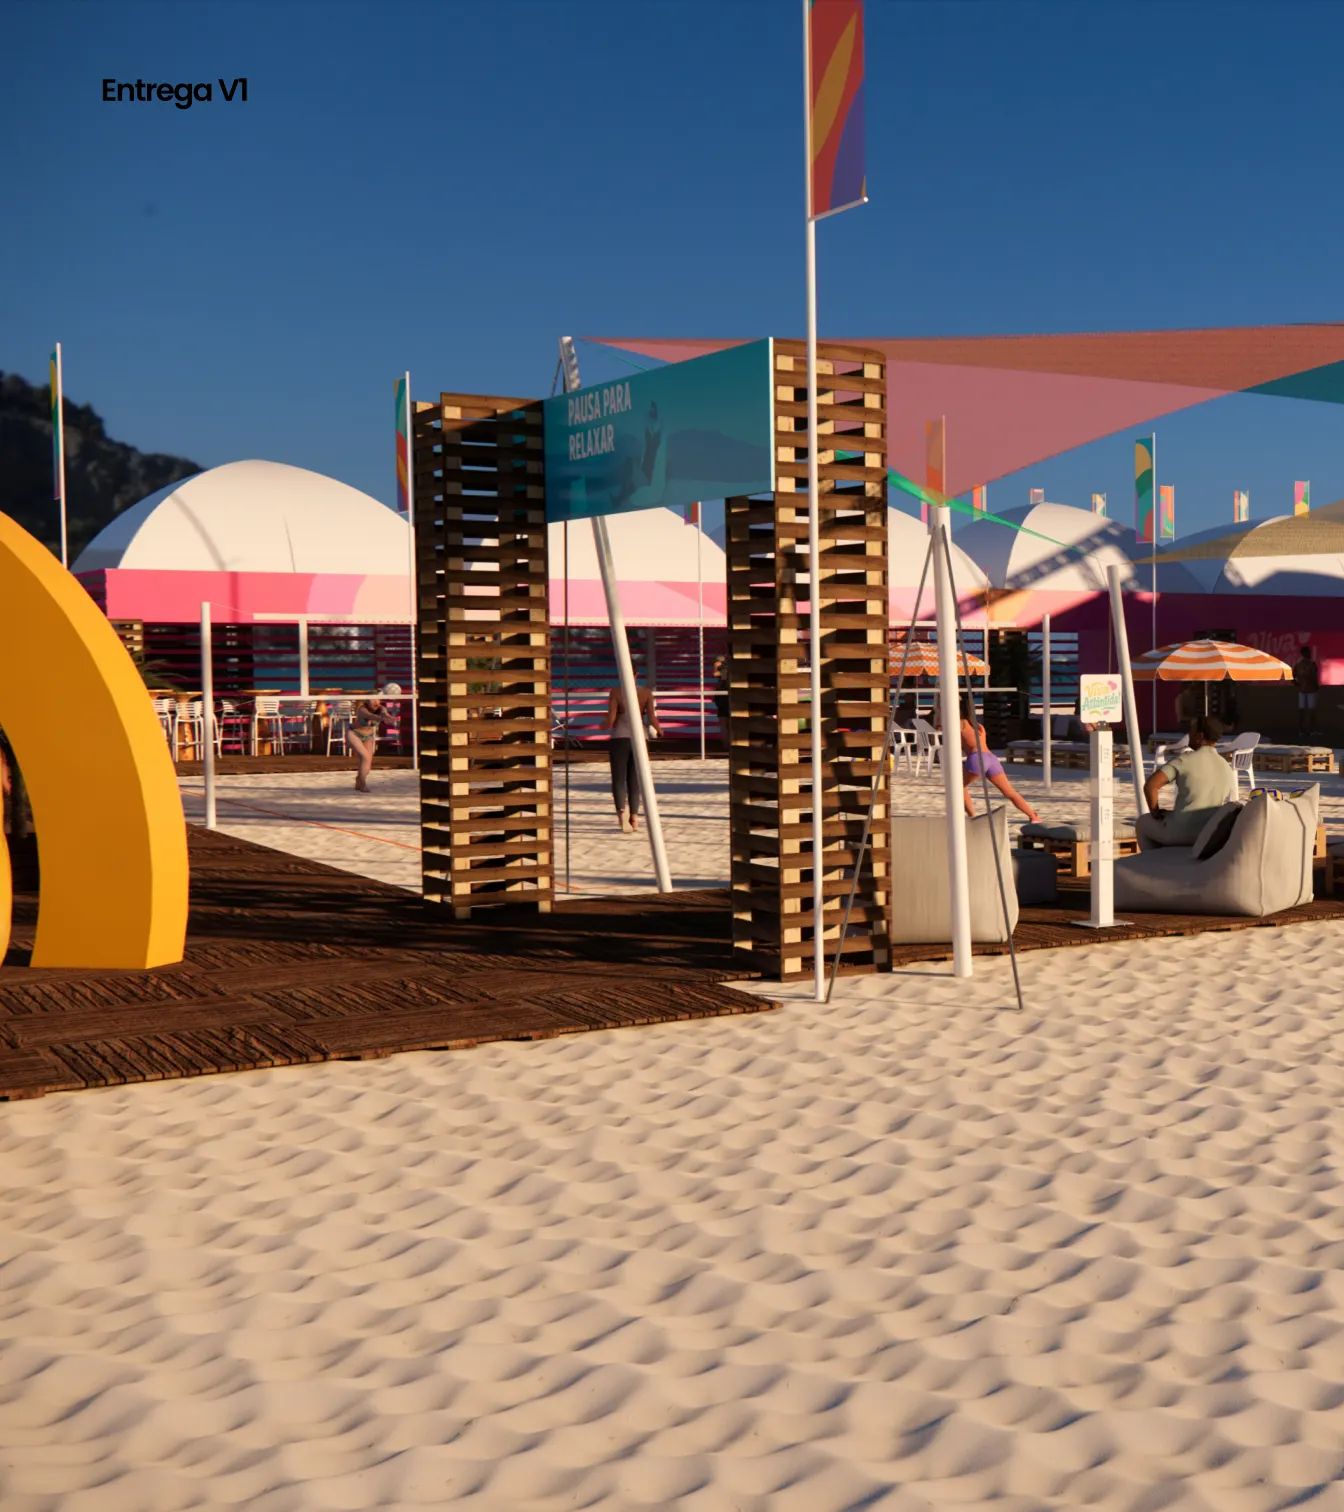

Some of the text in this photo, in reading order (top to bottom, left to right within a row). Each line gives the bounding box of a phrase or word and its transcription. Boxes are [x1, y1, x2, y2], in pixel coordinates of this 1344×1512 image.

[568, 381, 632, 427] PAUSA PARA
[569, 424, 615, 461] RELAXAR
